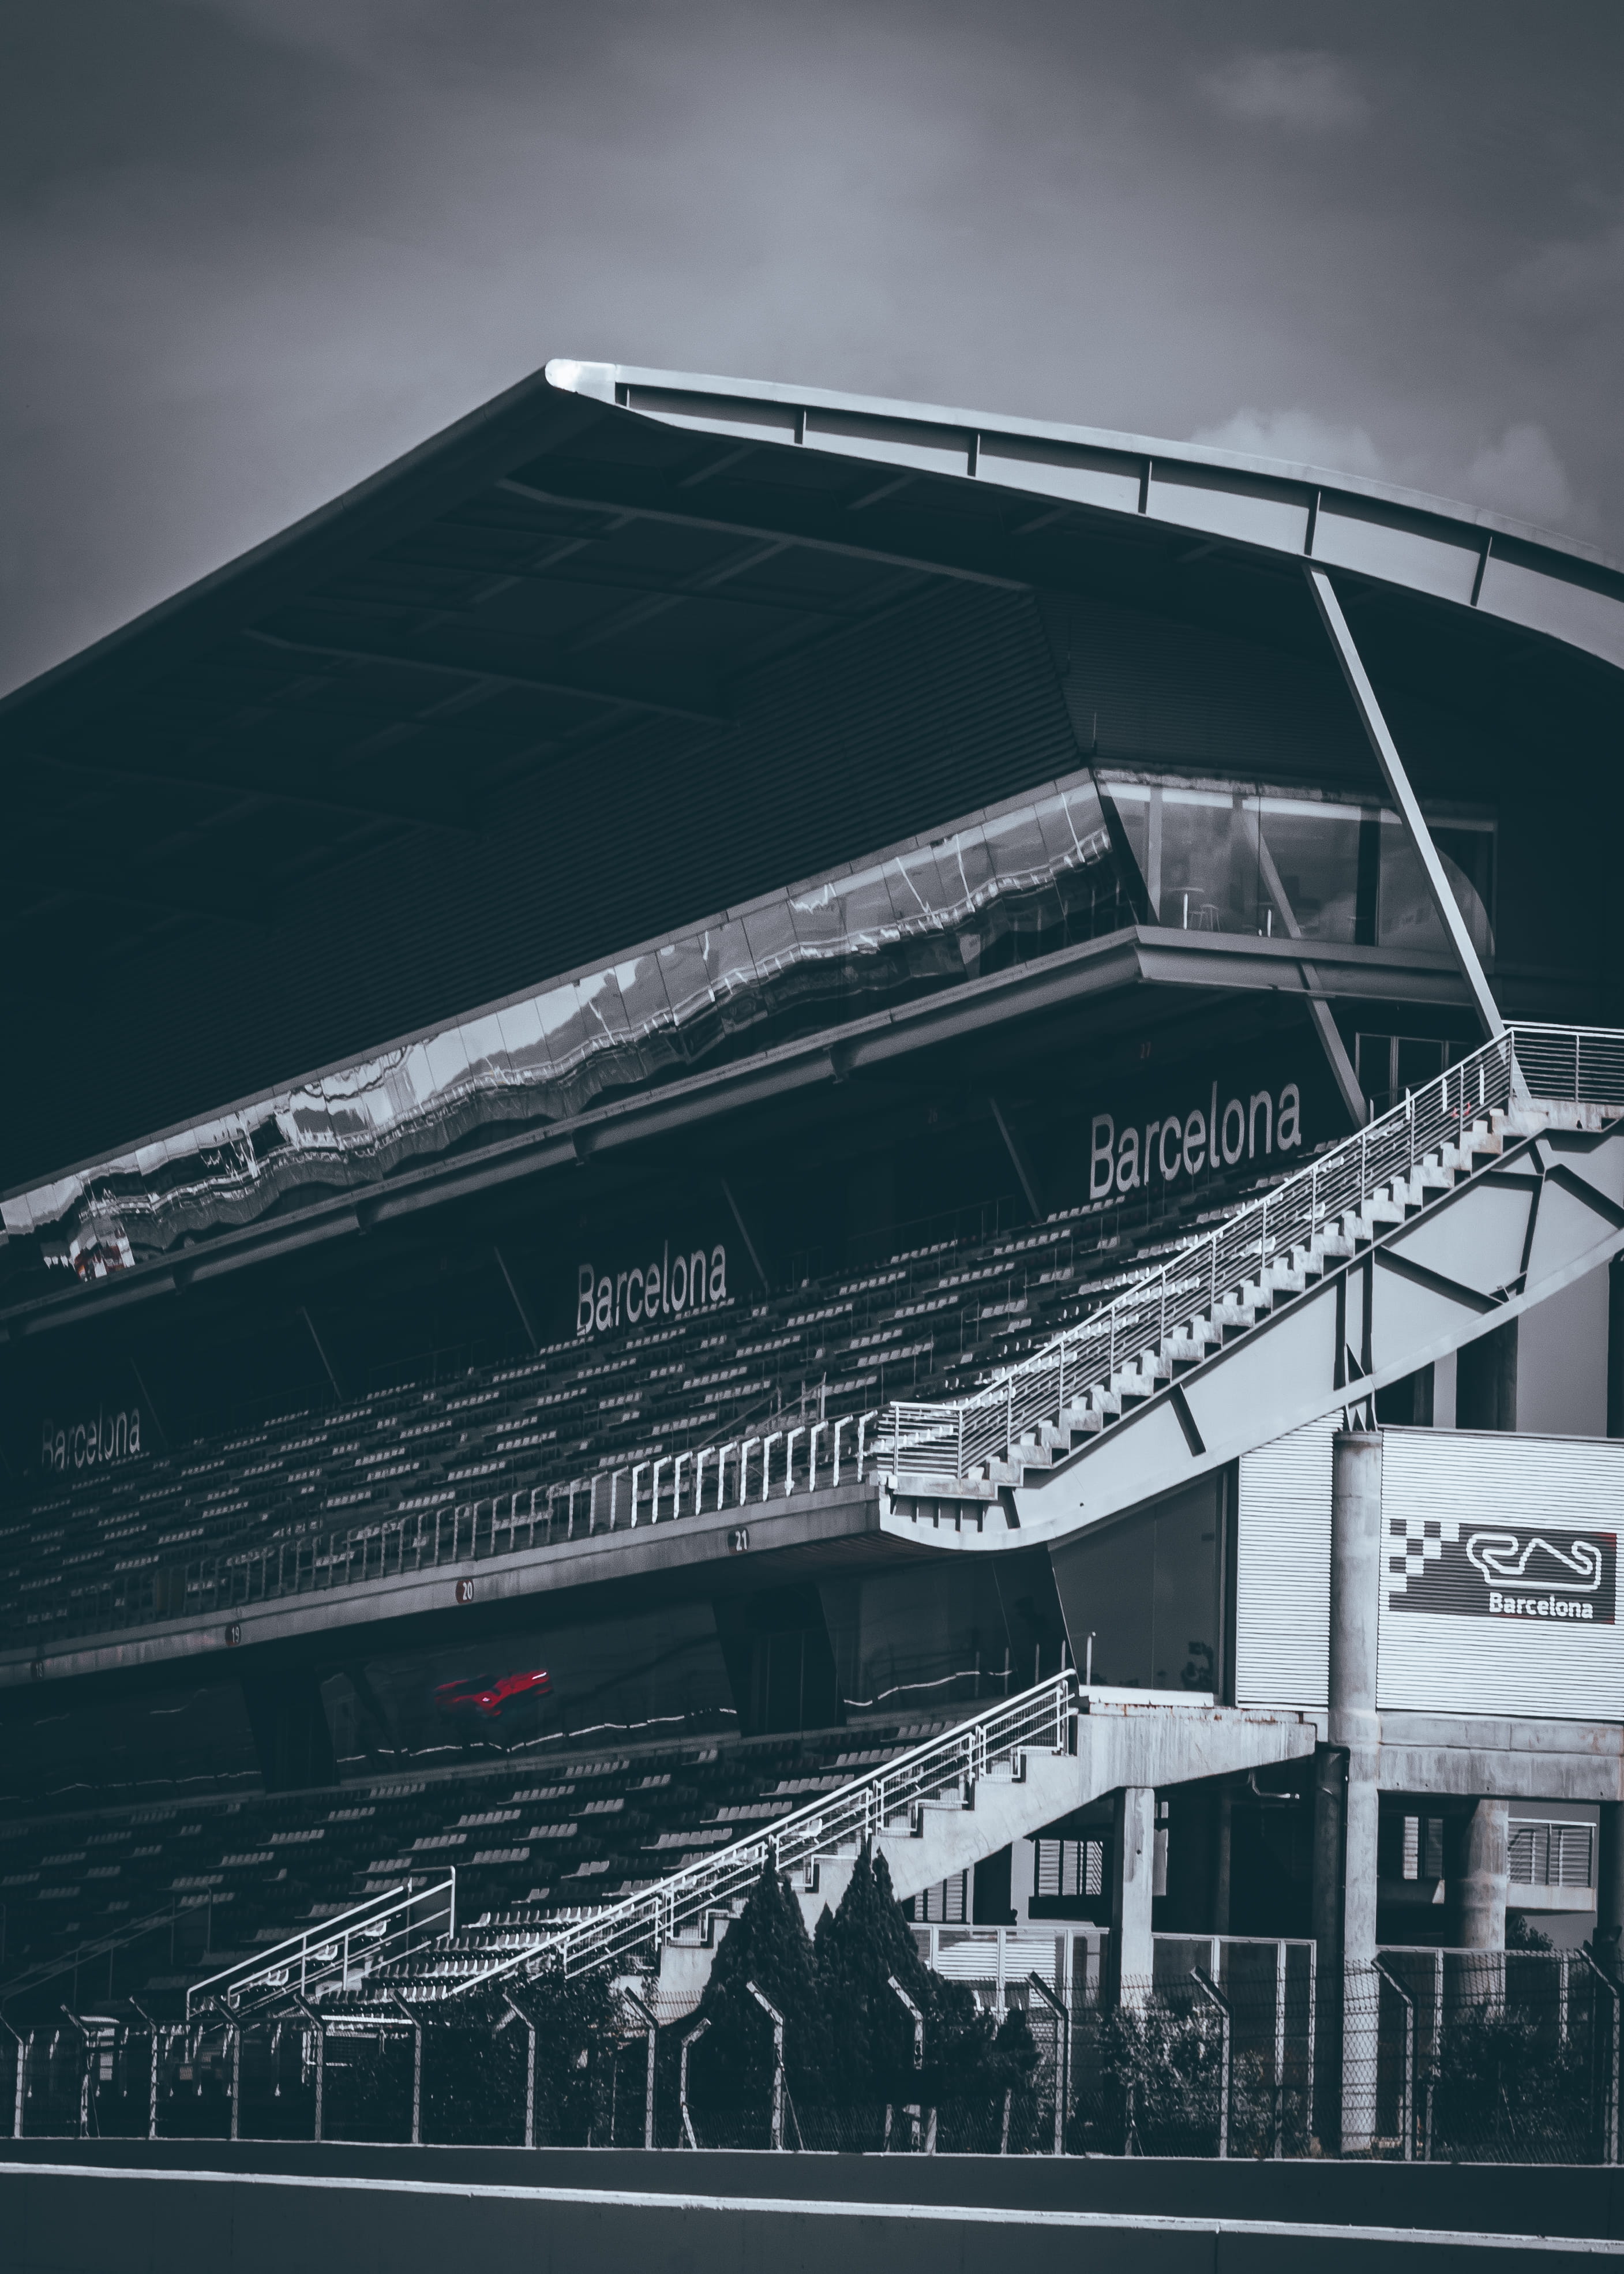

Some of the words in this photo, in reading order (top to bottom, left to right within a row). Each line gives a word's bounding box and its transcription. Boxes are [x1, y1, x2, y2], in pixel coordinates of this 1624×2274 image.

[1089, 1081, 1301, 1200] Barcelona
[577, 1240, 726, 1335] Barcelona
[42, 1403, 140, 1471] Barcelona
[736, 1530, 747, 1551] 21
[463, 1581, 472, 1600] 20
[1489, 1592, 1593, 1619] Barcelona
[232, 1626, 239, 1643] 19
